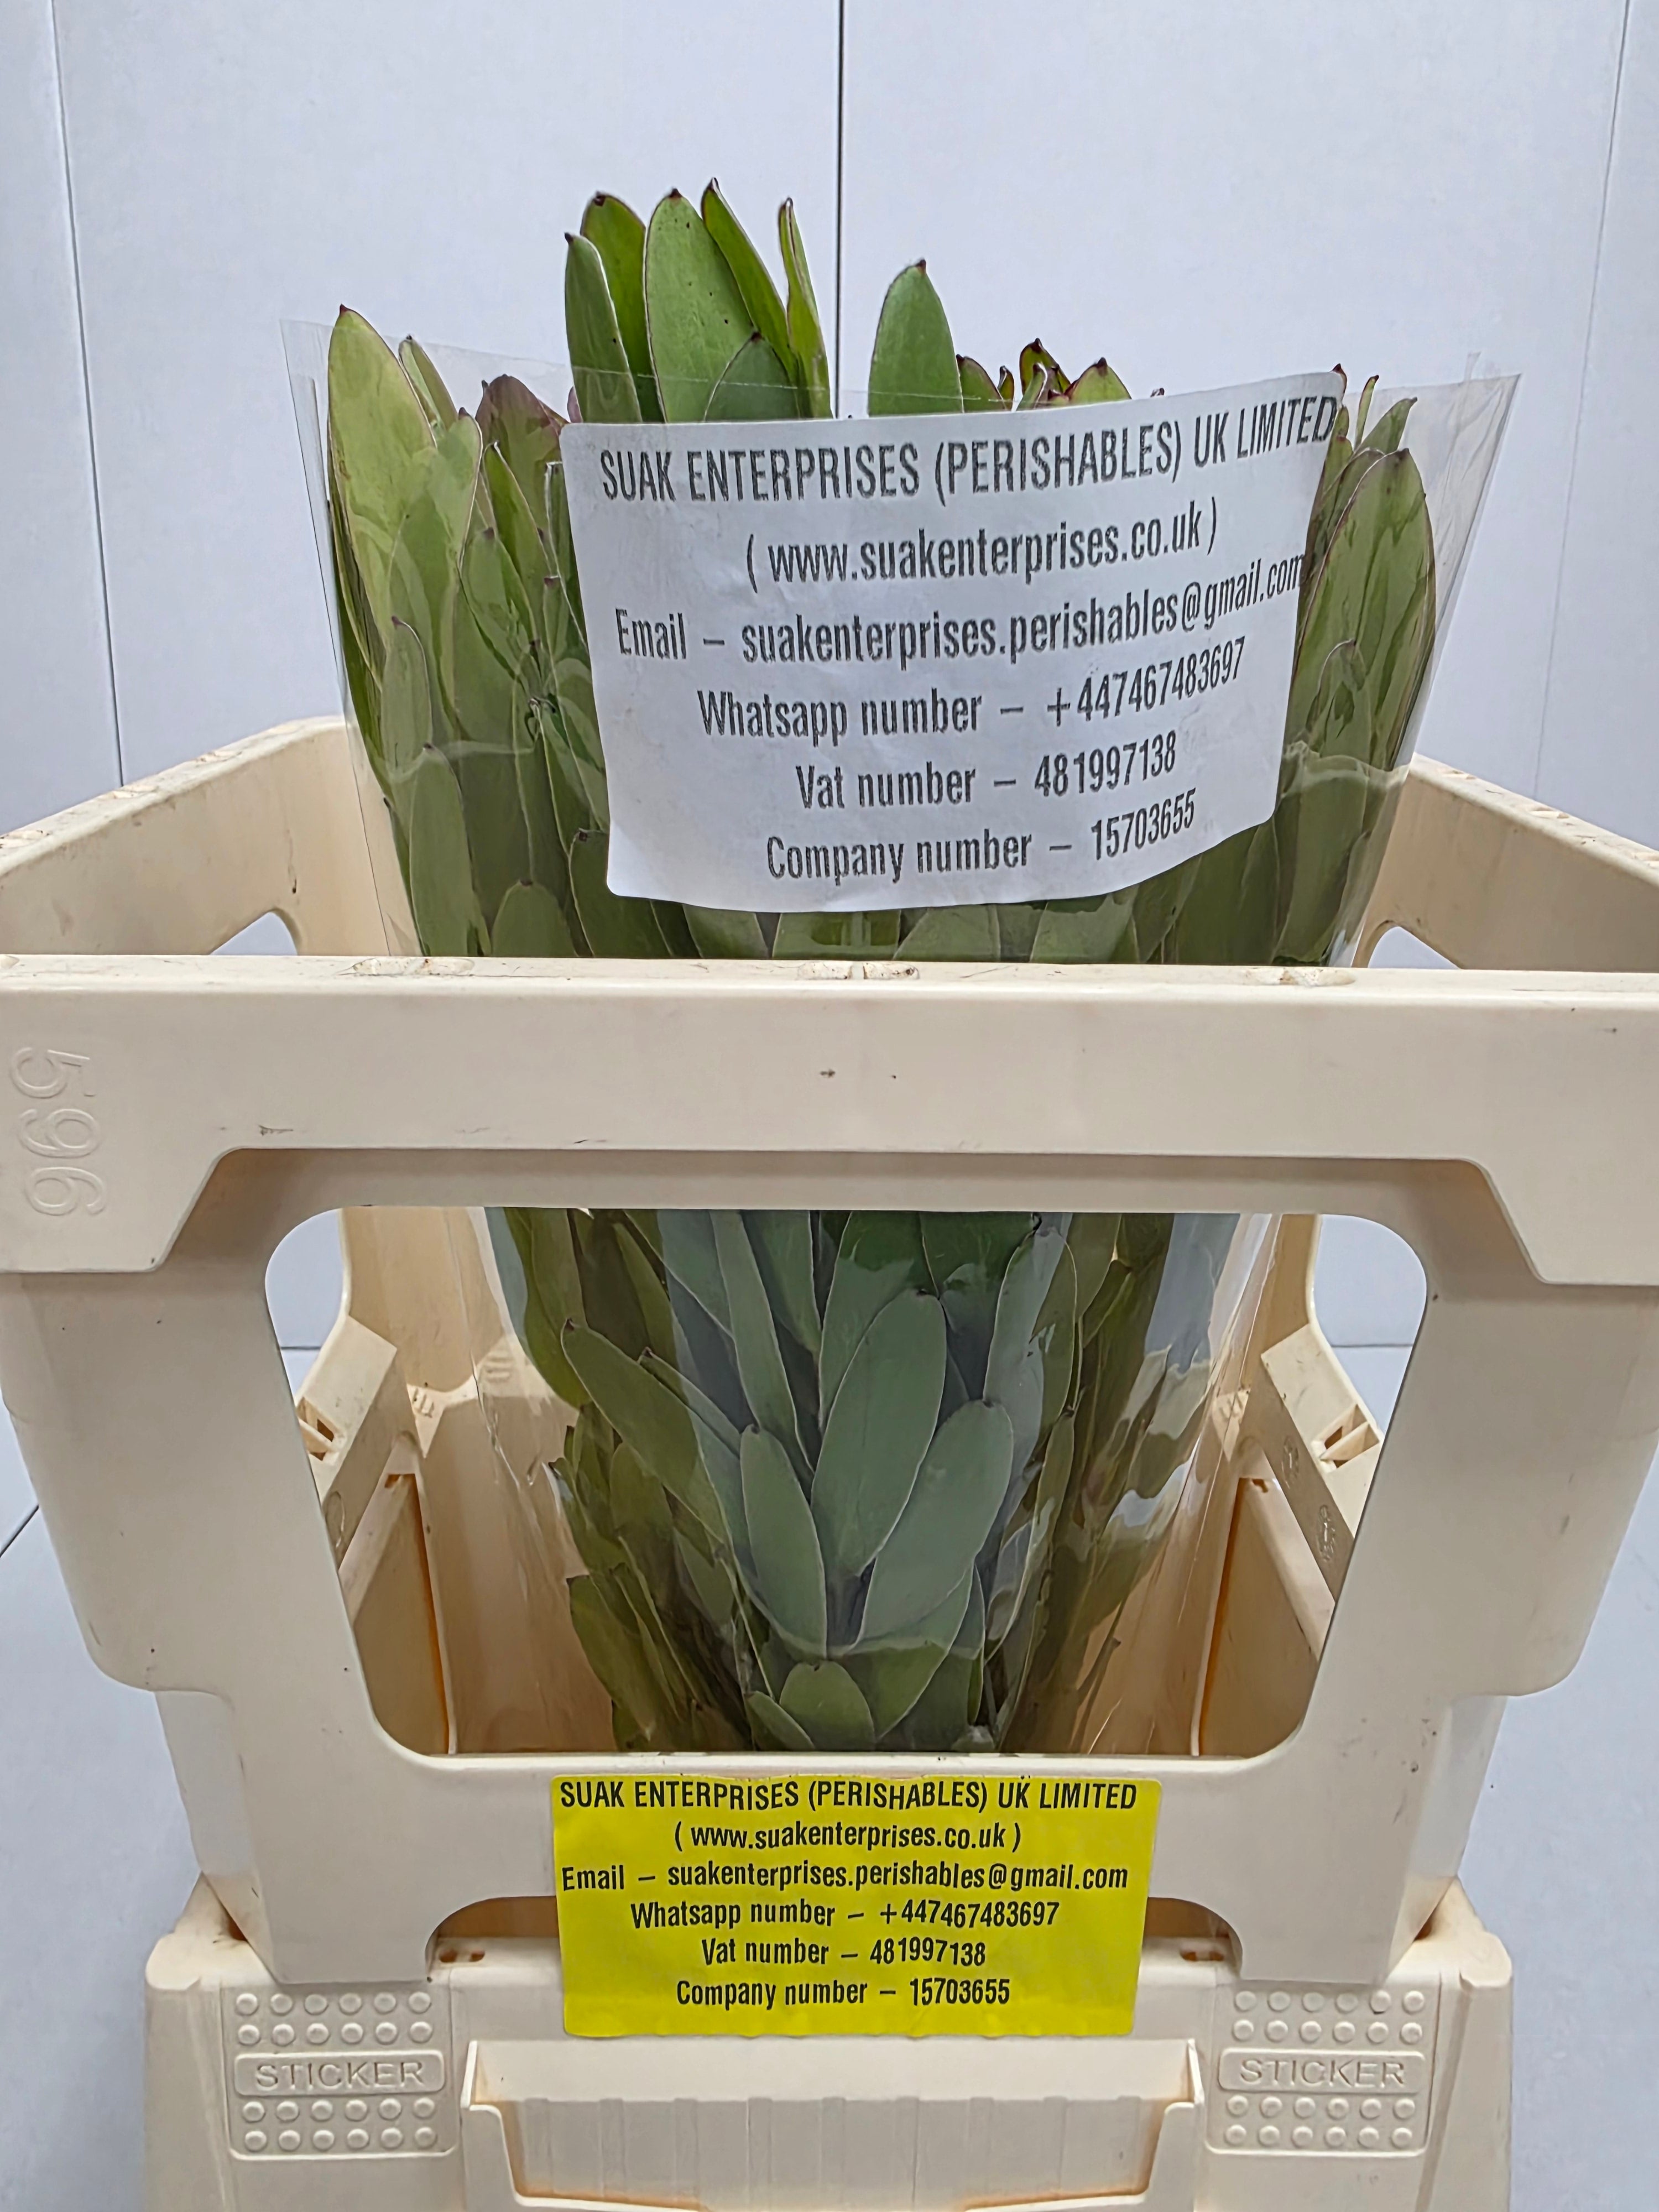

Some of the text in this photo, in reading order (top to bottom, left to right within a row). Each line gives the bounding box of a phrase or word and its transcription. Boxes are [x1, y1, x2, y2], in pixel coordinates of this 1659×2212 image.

[601, 396, 1338, 506] SUAK ENTERPRISES (PERISHABLES) UK LIMITED
[768, 500, 1202, 585] www.suakenterprises.co.uk
[615, 608, 687, 660] Email
[697, 690, 848, 748] Whatsapp
[862, 688, 982, 736] number
[1047, 636, 1245, 727] +447467483697
[796, 765, 845, 809] Vat
[858, 761, 975, 807] number
[1034, 729, 1177, 797] 481997138
[767, 836, 904, 886] Company
[917, 829, 1032, 873] number
[1091, 787, 1196, 860] 15703655
[9, 1047, 106, 1217] 596
[560, 1781, 1138, 1813] SUAK ENTERPRISES (PERISHABLES) UK LIMITED
[691, 1821, 1006, 1851] www.suakenterprises.co.uk
[561, 1864, 625, 1891] Email
[667, 1860, 1128, 1891] suakenterprises.perishables@gmail.com
[630, 1901, 742, 1929] Whatsapp
[750, 1898, 835, 1927] number
[880, 1899, 1060, 1928] +447467483697
[702, 1938, 736, 1965] Vat
[745, 1938, 829, 1965] number
[870, 1937, 986, 1966] 481997138
[676, 1980, 776, 2011] Company
[785, 1980, 868, 2005] number
[910, 1978, 1010, 2006] 15703655
[255, 2062, 425, 2090] STICKER
[1240, 2059, 1405, 2089] STICKER
